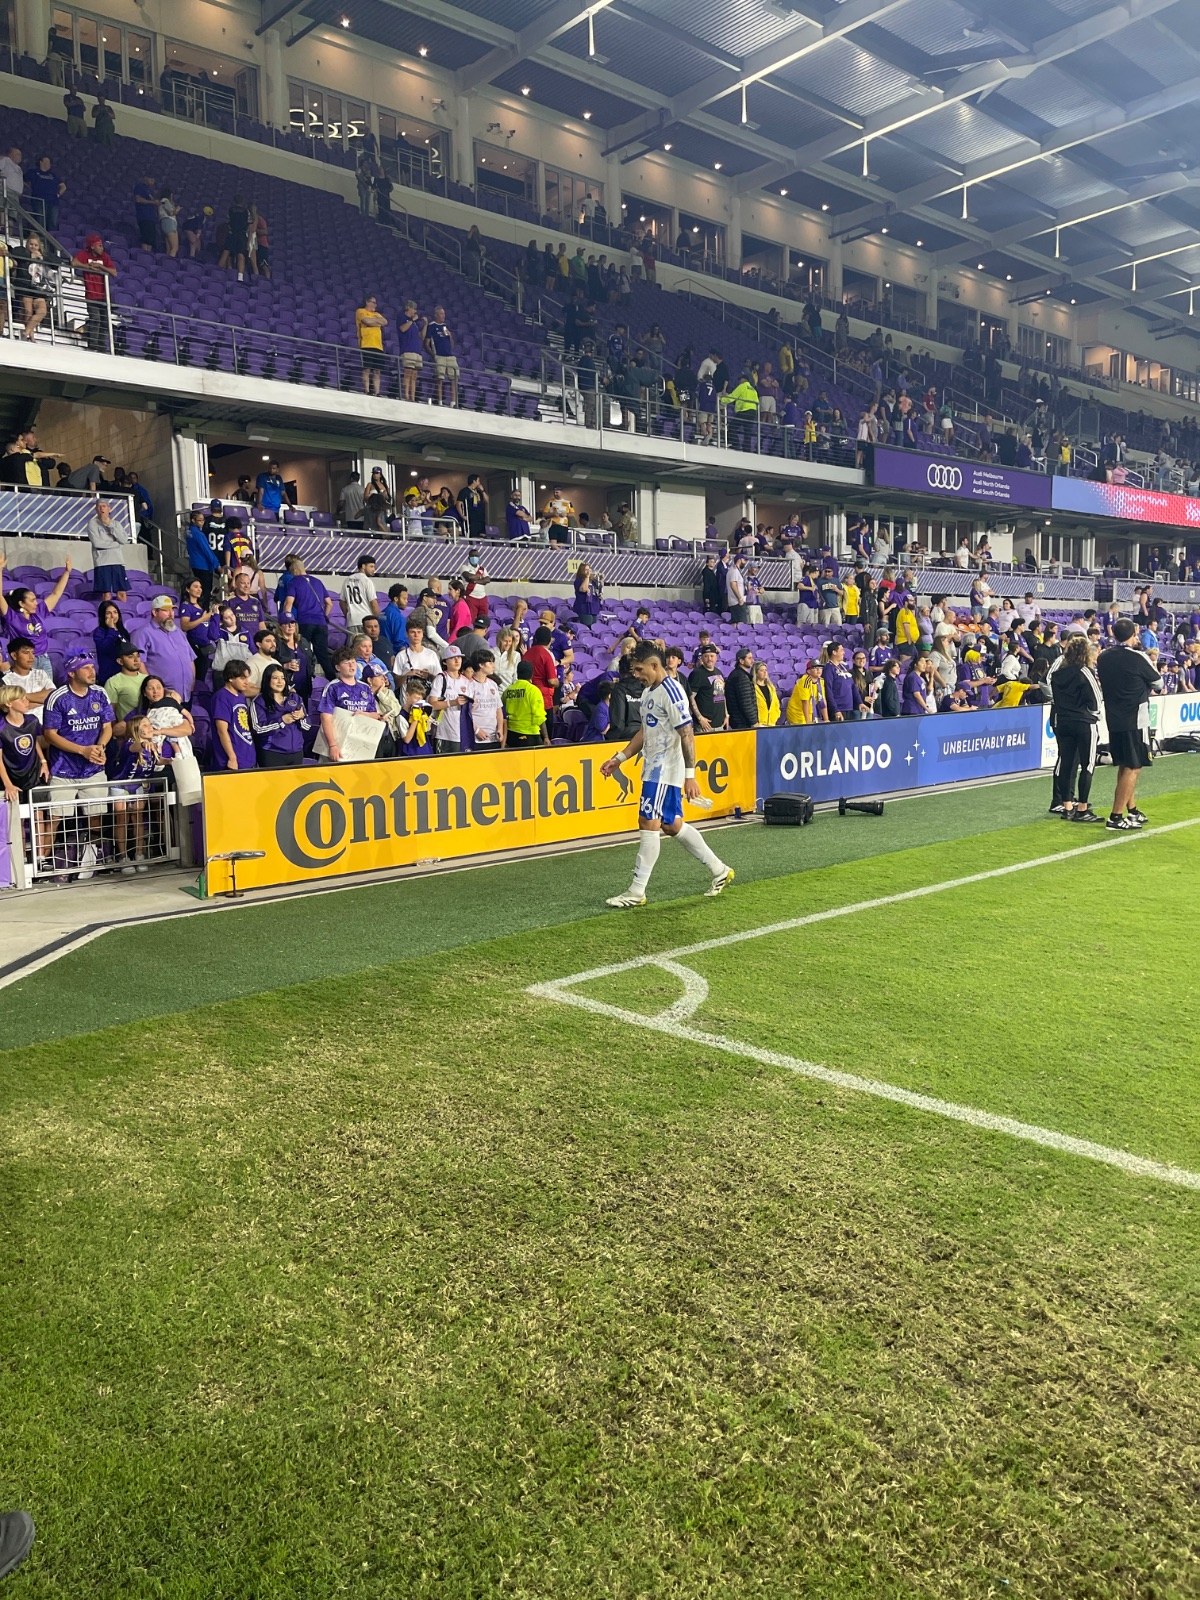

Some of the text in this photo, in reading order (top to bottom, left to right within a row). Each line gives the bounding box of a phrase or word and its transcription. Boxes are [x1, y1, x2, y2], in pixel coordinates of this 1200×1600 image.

[982, 480, 994, 488] North
[995, 482, 1010, 490] Orlando
[208, 532, 225, 551] 92
[572, 562, 578, 570] 11
[68, 716, 100, 725] ORLANDO
[72, 722, 98, 732] HEALTH
[942, 732, 1027, 756] UNBELIEVABLY REAL
[780, 743, 892, 781] ORLANDO
[275, 759, 595, 869] Continental
